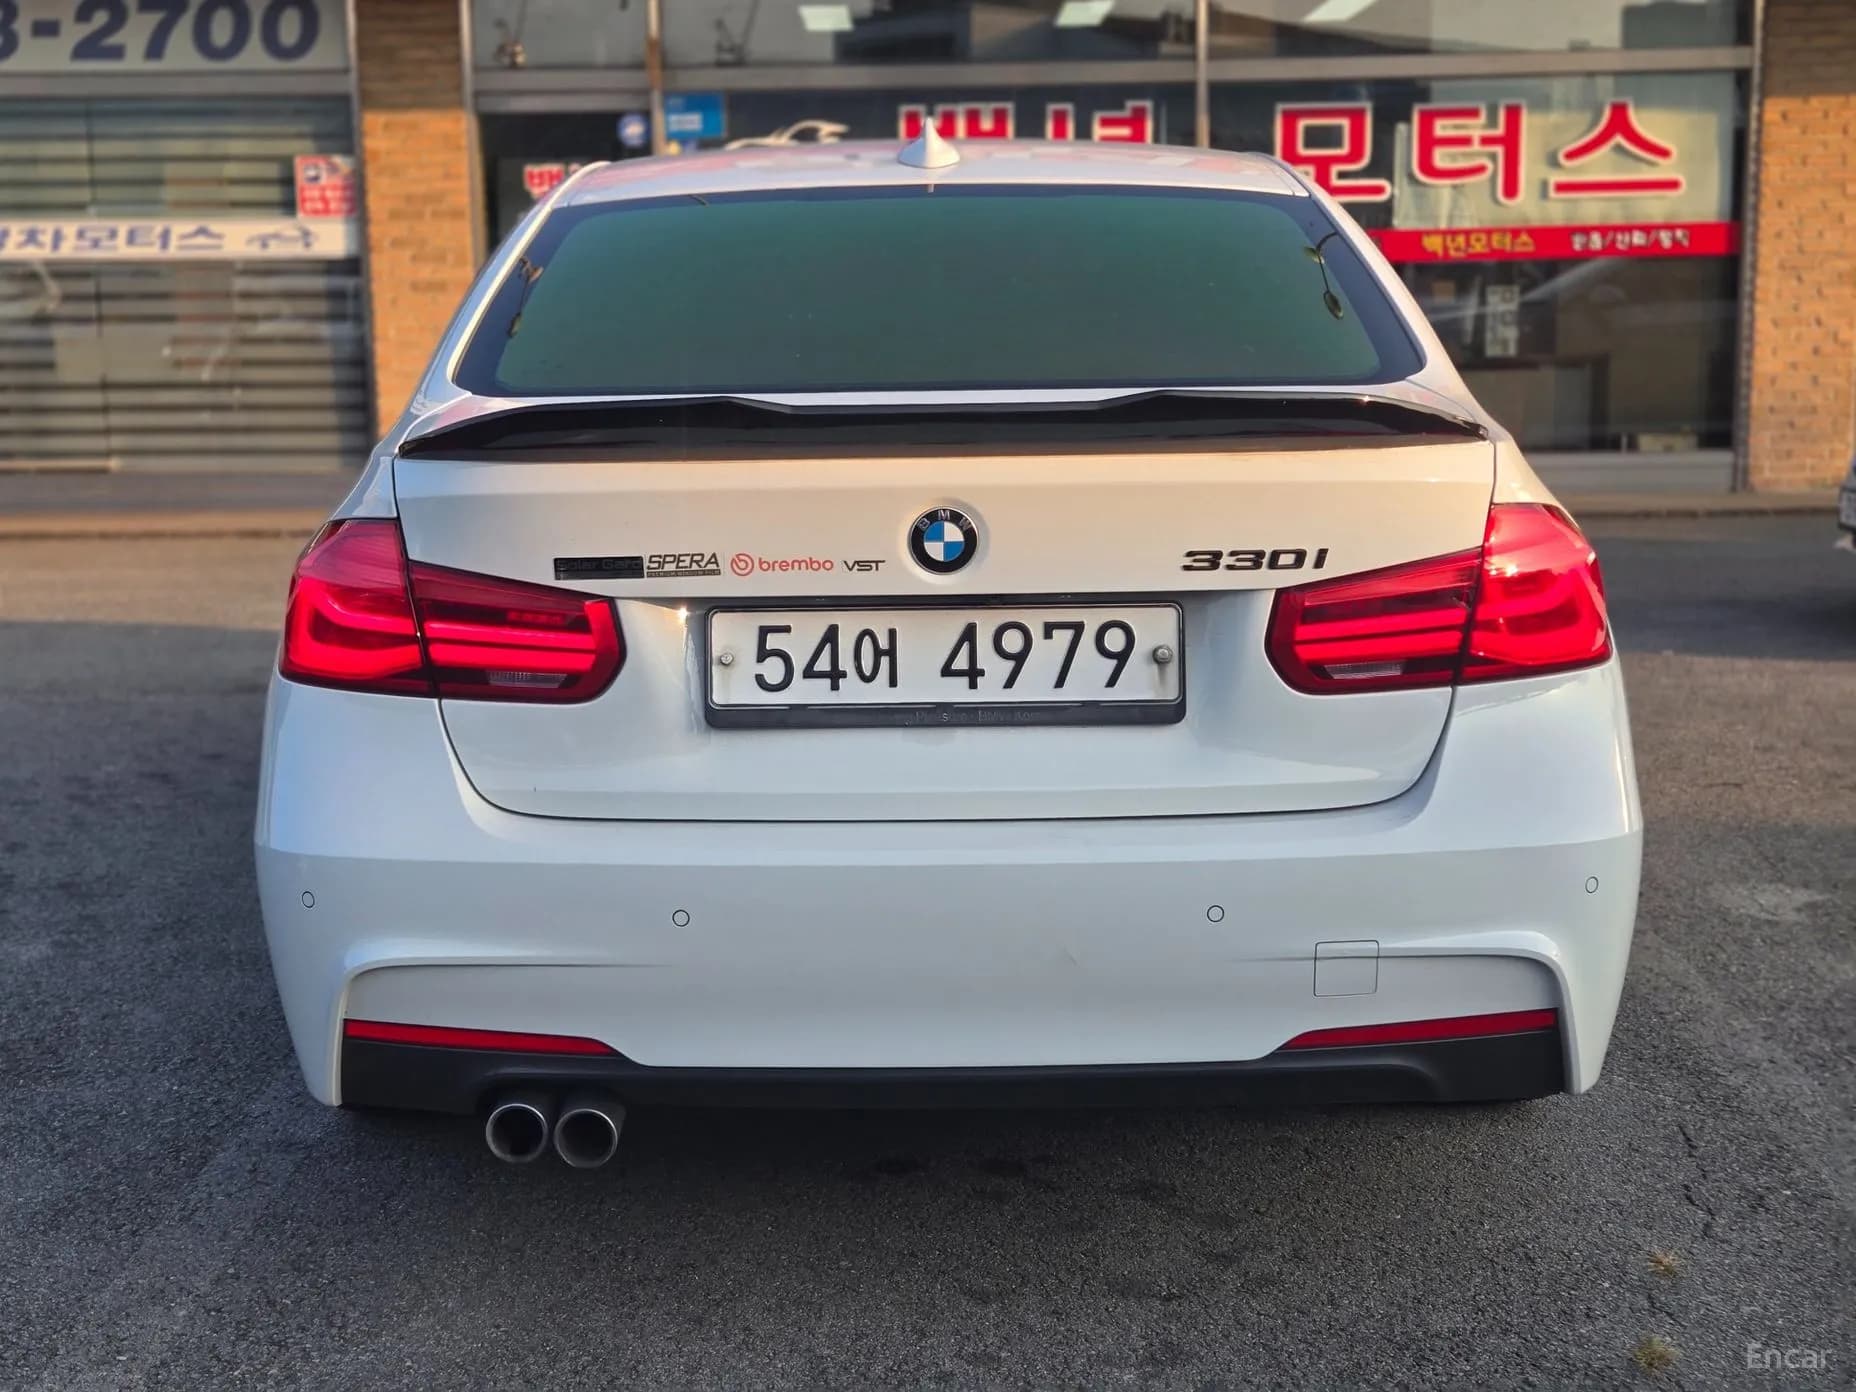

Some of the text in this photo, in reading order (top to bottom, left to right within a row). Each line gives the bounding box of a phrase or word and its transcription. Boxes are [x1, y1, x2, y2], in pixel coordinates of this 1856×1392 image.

[1275, 100, 1683, 204] 모터스
[917, 509, 973, 531] BMW
[647, 552, 720, 571] SPERA
[758, 557, 834, 571] brembo
[843, 560, 886, 572] VST
[754, 620, 1136, 693] 54어 4979
